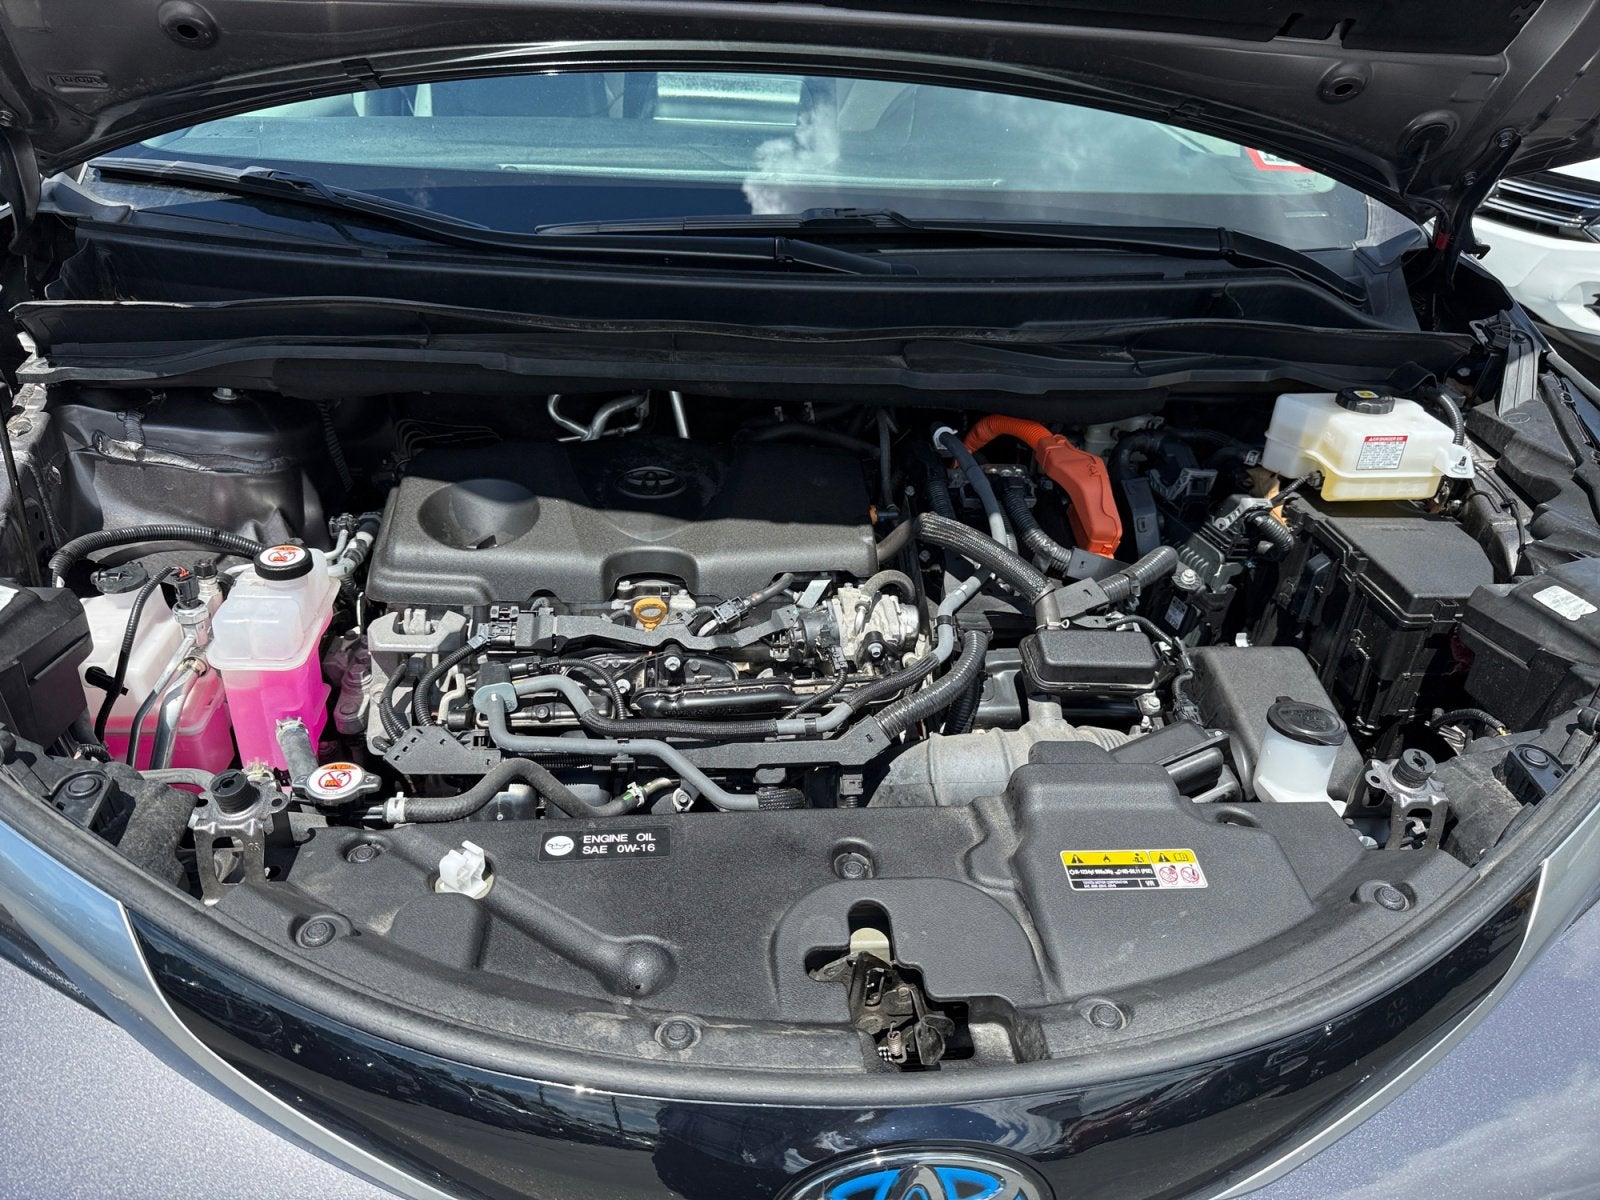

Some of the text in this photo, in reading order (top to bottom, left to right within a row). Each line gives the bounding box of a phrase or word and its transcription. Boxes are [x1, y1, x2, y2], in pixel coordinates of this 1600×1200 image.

[583, 833, 656, 844] ENGINE OIL
[582, 843, 656, 855] SAE 0W-16
